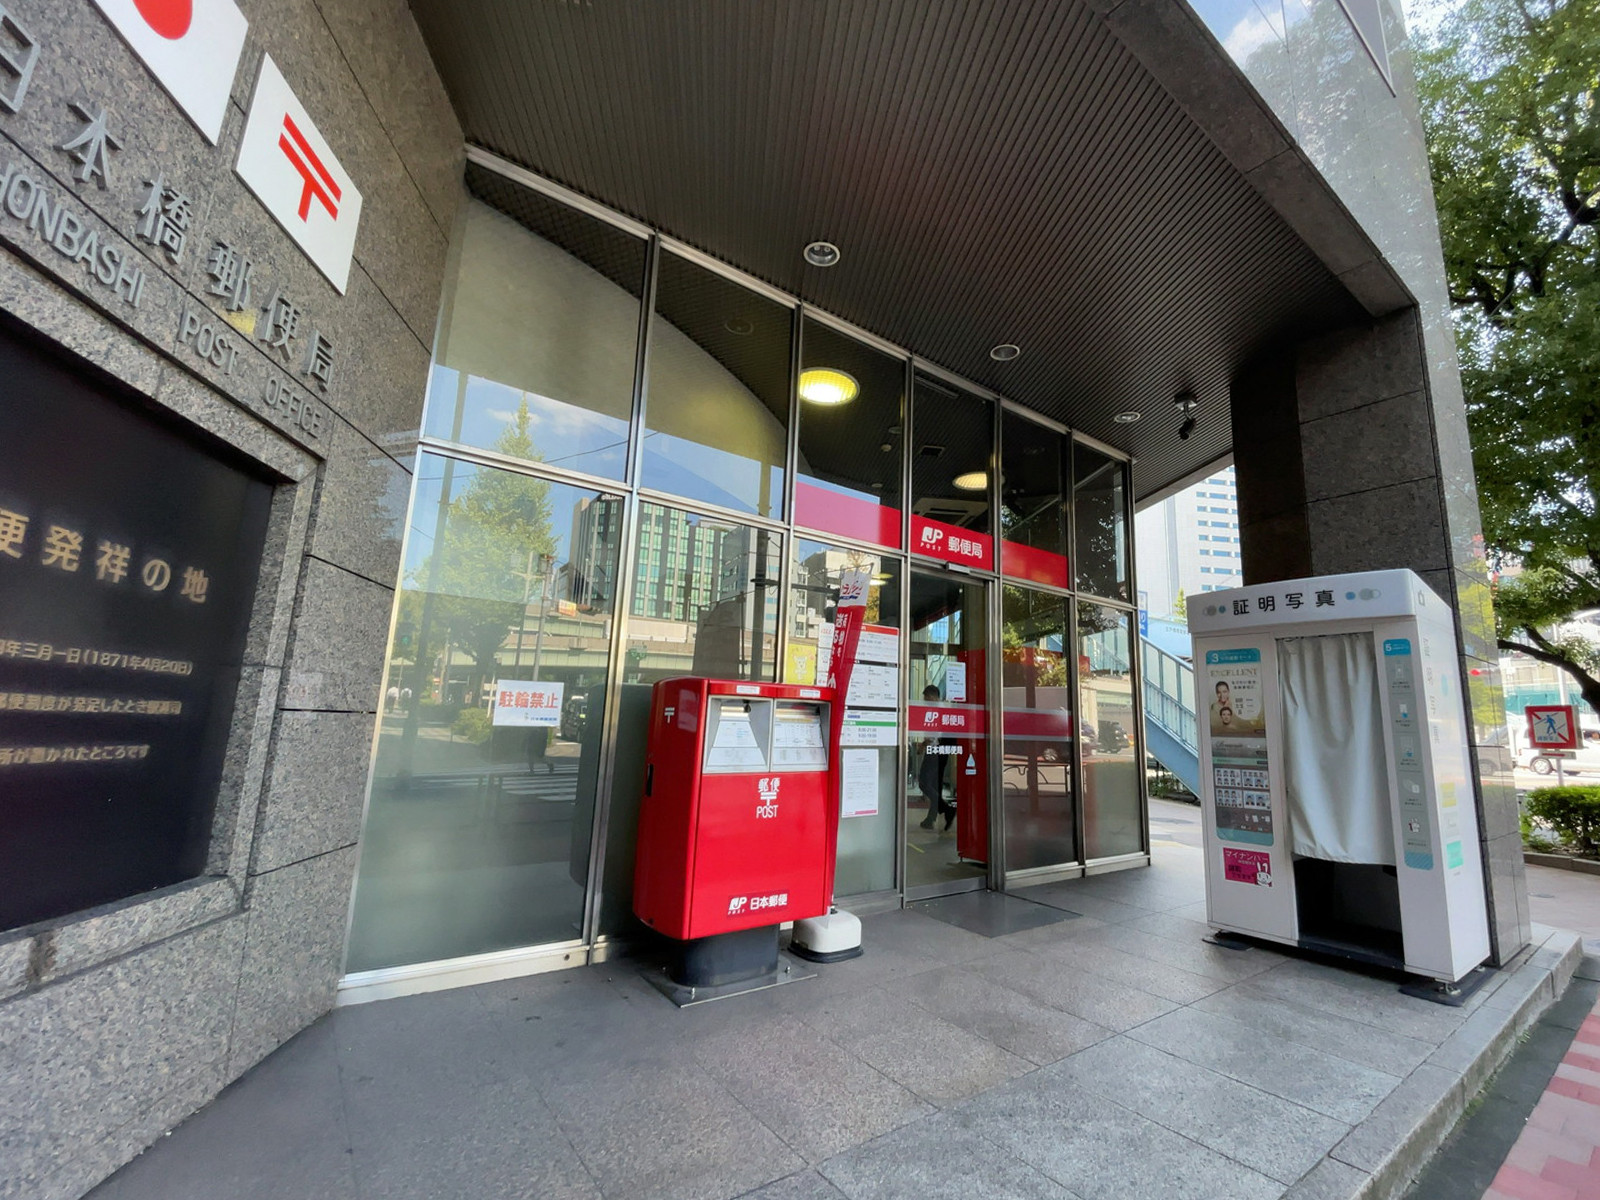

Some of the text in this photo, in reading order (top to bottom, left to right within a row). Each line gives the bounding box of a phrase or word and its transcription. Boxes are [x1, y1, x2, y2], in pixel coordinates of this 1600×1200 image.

[0, 12, 334, 391] 日本橋郵便局
[177, 310, 241, 375] POST
[263, 376, 321, 439] OFFICE
[919, 542, 943, 552] POST
[948, 536, 983, 559] 郵便局
[1232, 589, 1336, 616] 証明写真
[0, 639, 193, 675] 年三月一日(1871年4月20日)
[1211, 653, 1219, 663] 3
[498, 690, 558, 708] 駐輪禁止
[941, 714, 965, 727] 郵便局
[926, 745, 963, 755] 日本橋郵便局
[758, 778, 780, 793] 郵便
[756, 805, 779, 818] POST
[750, 893, 788, 910] 日本郵便
